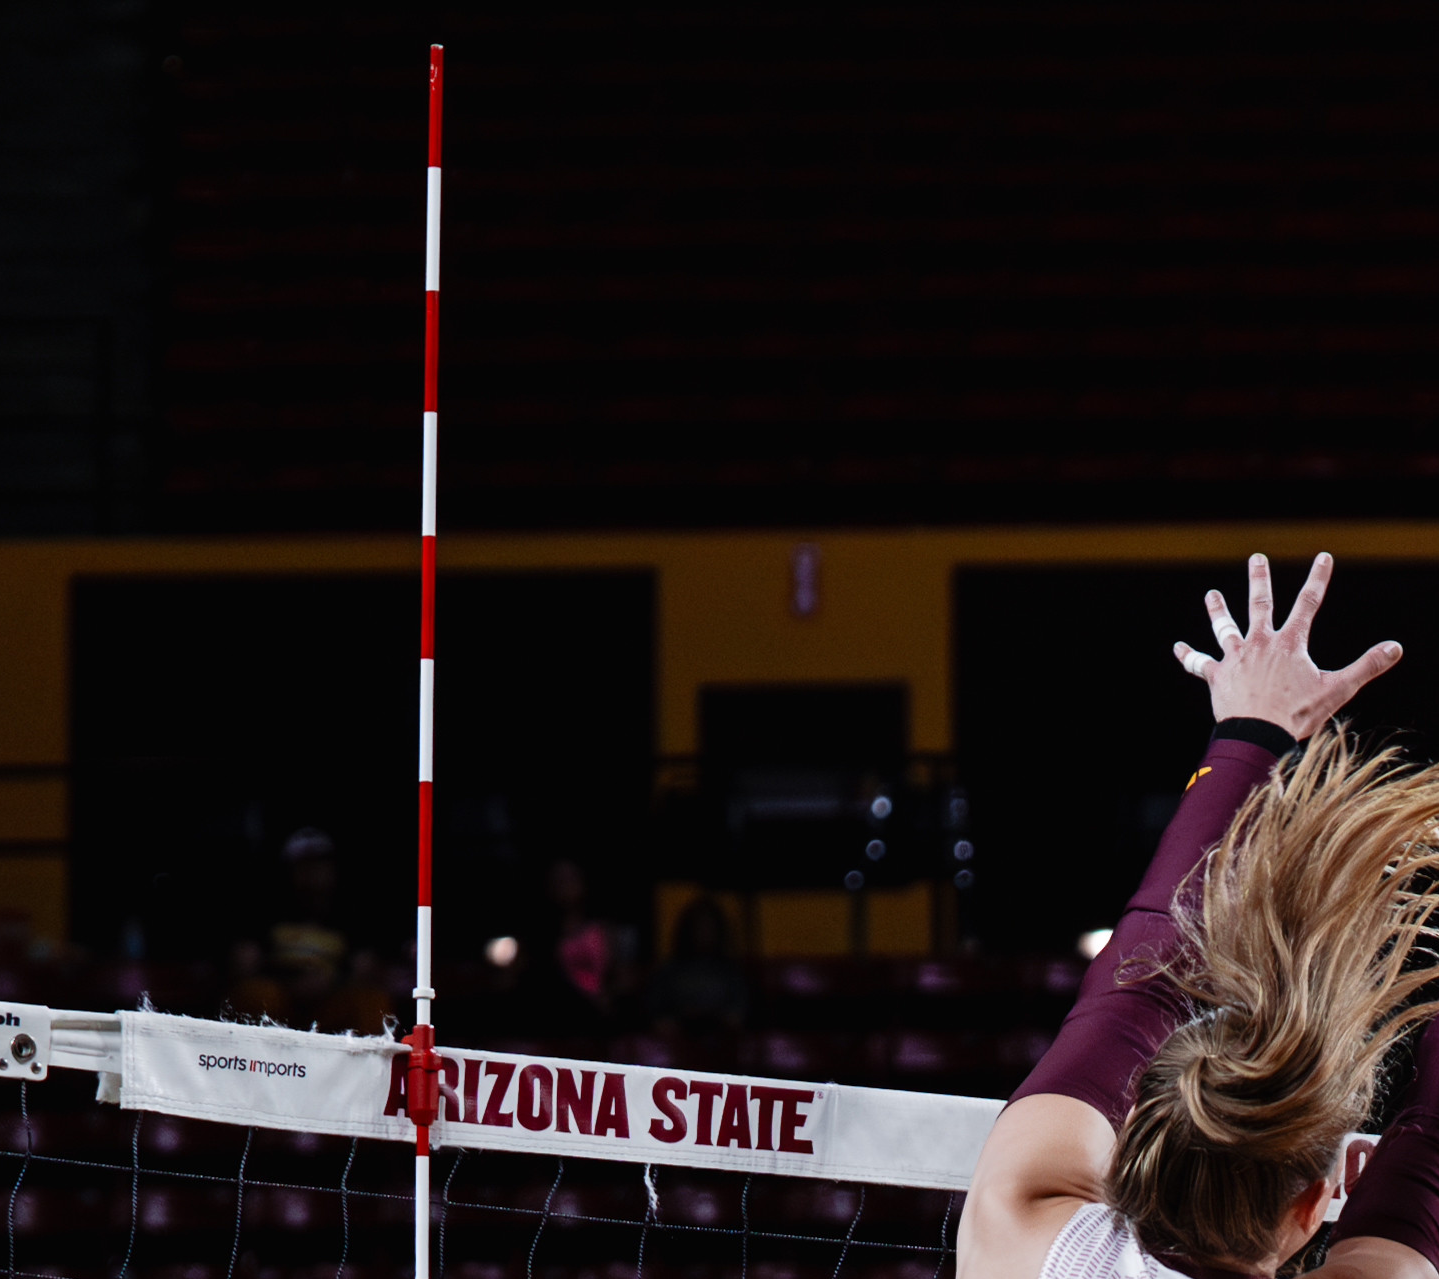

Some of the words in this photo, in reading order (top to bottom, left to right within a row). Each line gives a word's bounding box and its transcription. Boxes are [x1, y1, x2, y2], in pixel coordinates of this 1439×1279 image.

[198, 1054, 248, 1071] sports
[249, 1059, 307, 1078] imports
[648, 1076, 815, 1155] STATE
